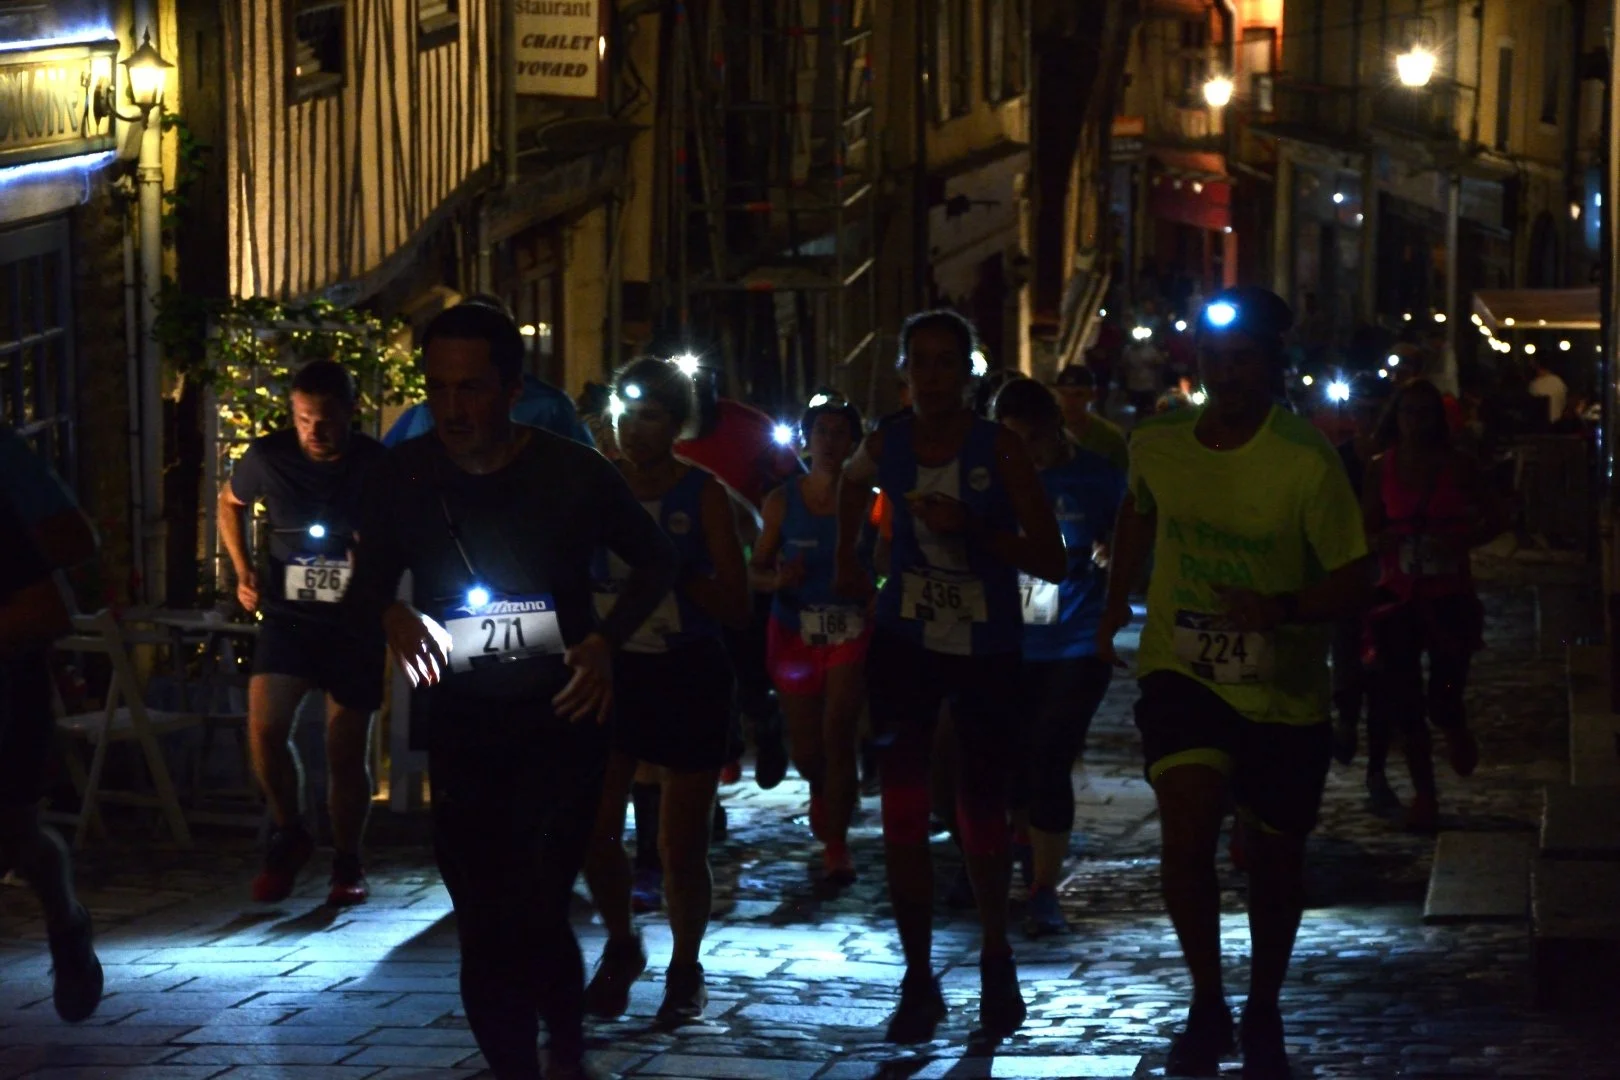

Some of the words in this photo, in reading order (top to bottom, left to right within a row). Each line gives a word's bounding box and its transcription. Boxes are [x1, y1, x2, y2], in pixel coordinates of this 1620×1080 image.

[521, 33, 594, 50] CHALET
[305, 568, 341, 590] 626
[922, 581, 962, 609] 436
[481, 617, 525, 653] 271
[1198, 632, 1248, 664] 224
